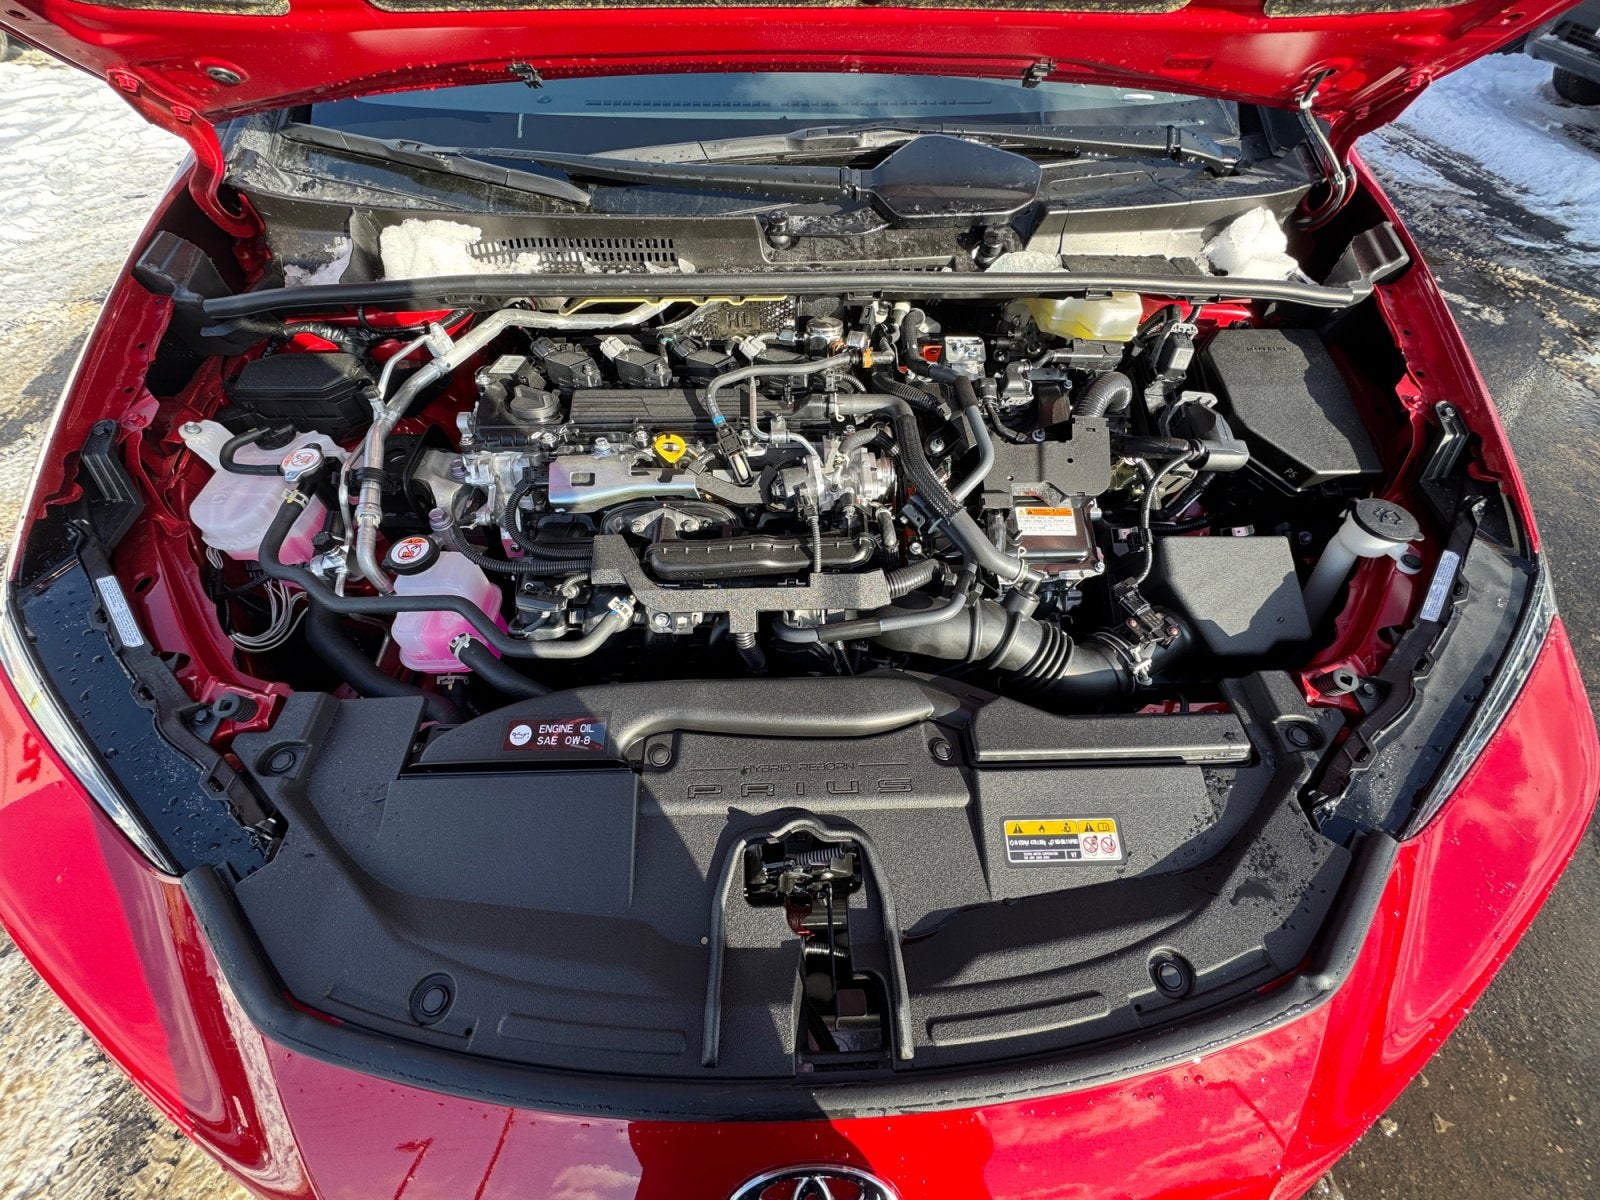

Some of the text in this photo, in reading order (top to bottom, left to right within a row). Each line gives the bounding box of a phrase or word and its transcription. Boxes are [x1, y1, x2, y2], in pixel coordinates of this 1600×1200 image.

[538, 723, 596, 735] ENGINE OIL
[536, 735, 591, 747] SAE 0W-8
[744, 762, 855, 774] HYBRID REBORN
[687, 777, 914, 799] PRIUS
